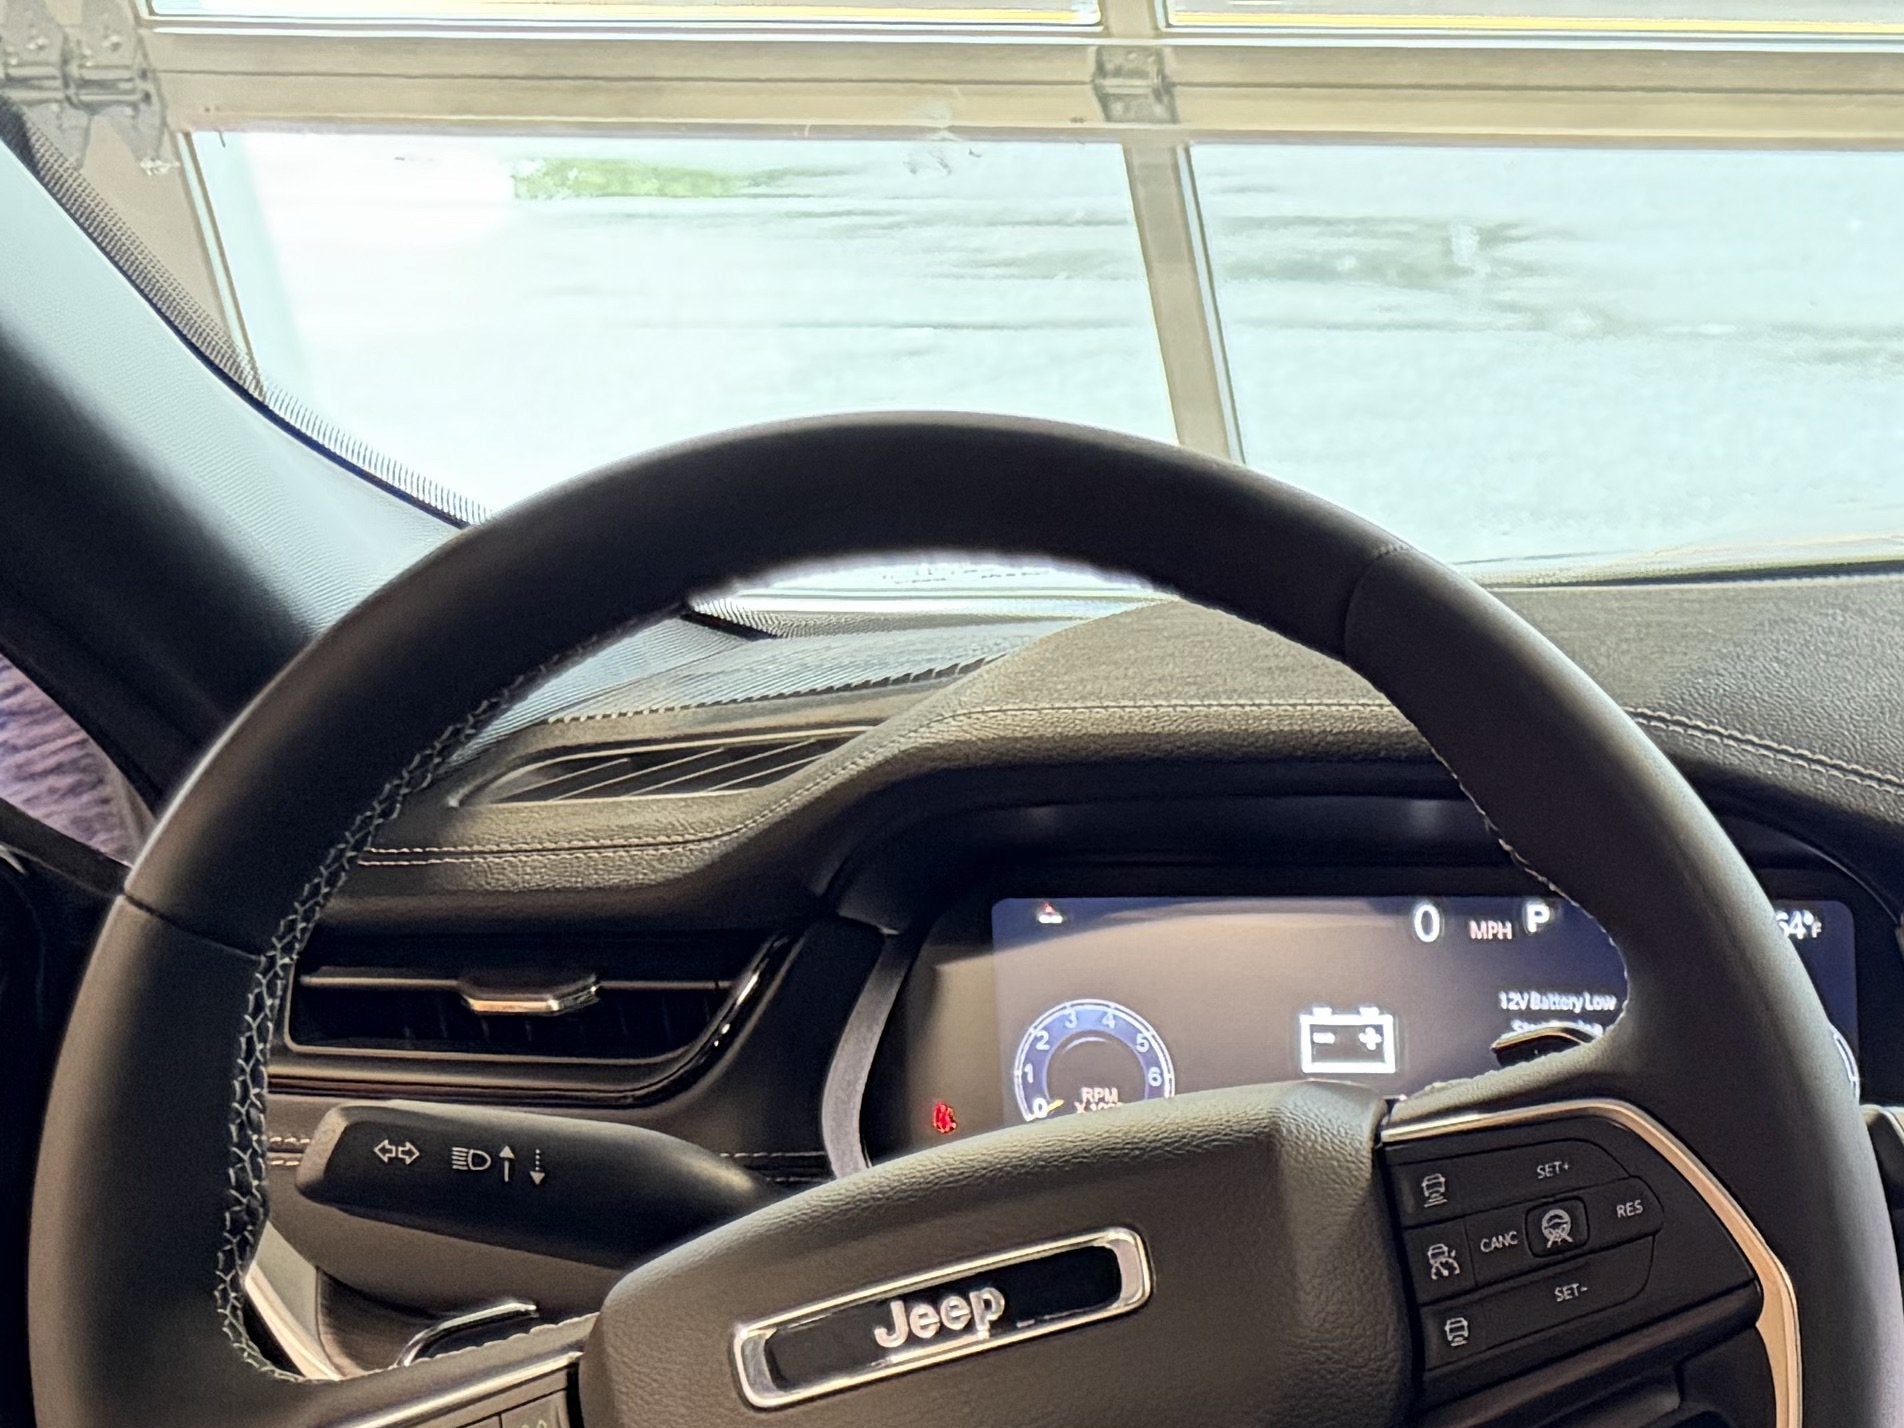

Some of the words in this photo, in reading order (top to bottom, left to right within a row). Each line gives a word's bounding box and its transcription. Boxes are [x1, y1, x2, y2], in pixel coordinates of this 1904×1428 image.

[1413, 904, 1441, 942] 0
[1469, 919, 1513, 940] MPH
[1526, 903, 1551, 933] P
[1499, 991, 1530, 1010] 12V
[1530, 991, 1583, 1013] Battery
[1584, 991, 1616, 1011] Low
[1064, 1008, 1078, 1028] 3
[1102, 1009, 1116, 1030] 4
[1035, 1029, 1050, 1050] 2
[1135, 1031, 1150, 1053] 5
[1024, 1062, 1035, 1084] 1
[1147, 1066, 1163, 1087] 6
[1080, 1086, 1119, 1102] RPM
[1032, 1096, 1049, 1119] 0
[1536, 1160, 1571, 1179] SET+
[1616, 1200, 1644, 1218] RES
[1479, 1230, 1519, 1254] CANC
[1554, 1283, 1589, 1302] SET-
[874, 1286, 1006, 1350] Jeep
